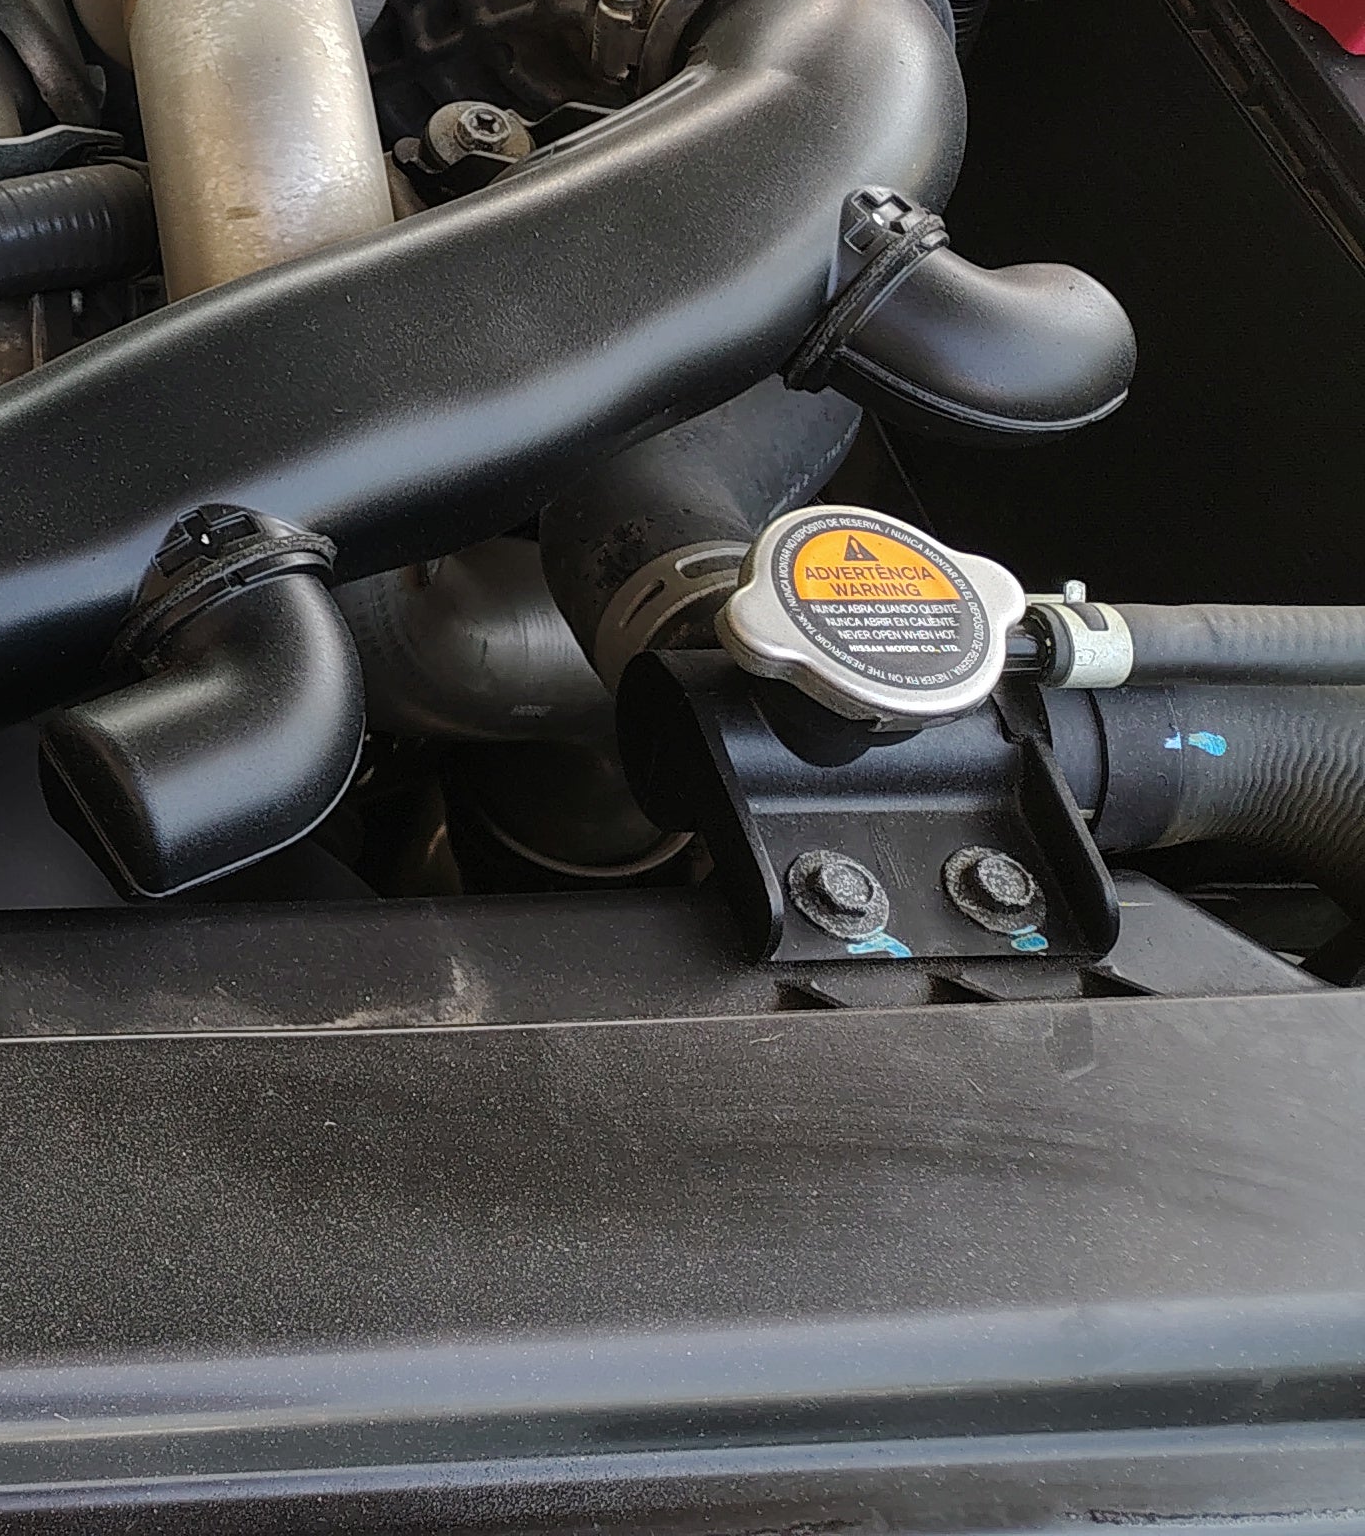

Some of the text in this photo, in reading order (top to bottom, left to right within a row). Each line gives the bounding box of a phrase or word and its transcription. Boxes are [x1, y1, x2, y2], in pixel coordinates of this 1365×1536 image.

[826, 518, 839, 528] DE
[891, 528, 923, 551] NUNCA
[924, 548, 958, 579] MONTAR
[955, 578, 968, 591] EN
[805, 564, 936, 581] ADVERTÊNCIA
[829, 582, 922, 597] WARNING
[810, 604, 847, 614] NUNCA
[848, 604, 875, 614] ABRA
[875, 604, 918, 614] QUANDO
[825, 617, 863, 627] NUNCA
[864, 617, 894, 627] ABRIR
[894, 617, 910, 627] EN
[837, 630, 872, 640] NEVER
[872, 630, 903, 640] OPEN
[902, 630, 935, 640] WHEN
[814, 633, 866, 671] RESERVOIR
[849, 644, 885, 653] NISSAN
[885, 644, 921, 653] MOTOR
[867, 665, 886, 680] THE
[888, 672, 903, 683] ON
[920, 671, 950, 685] NEVER
[905, 675, 920, 685] FIX
